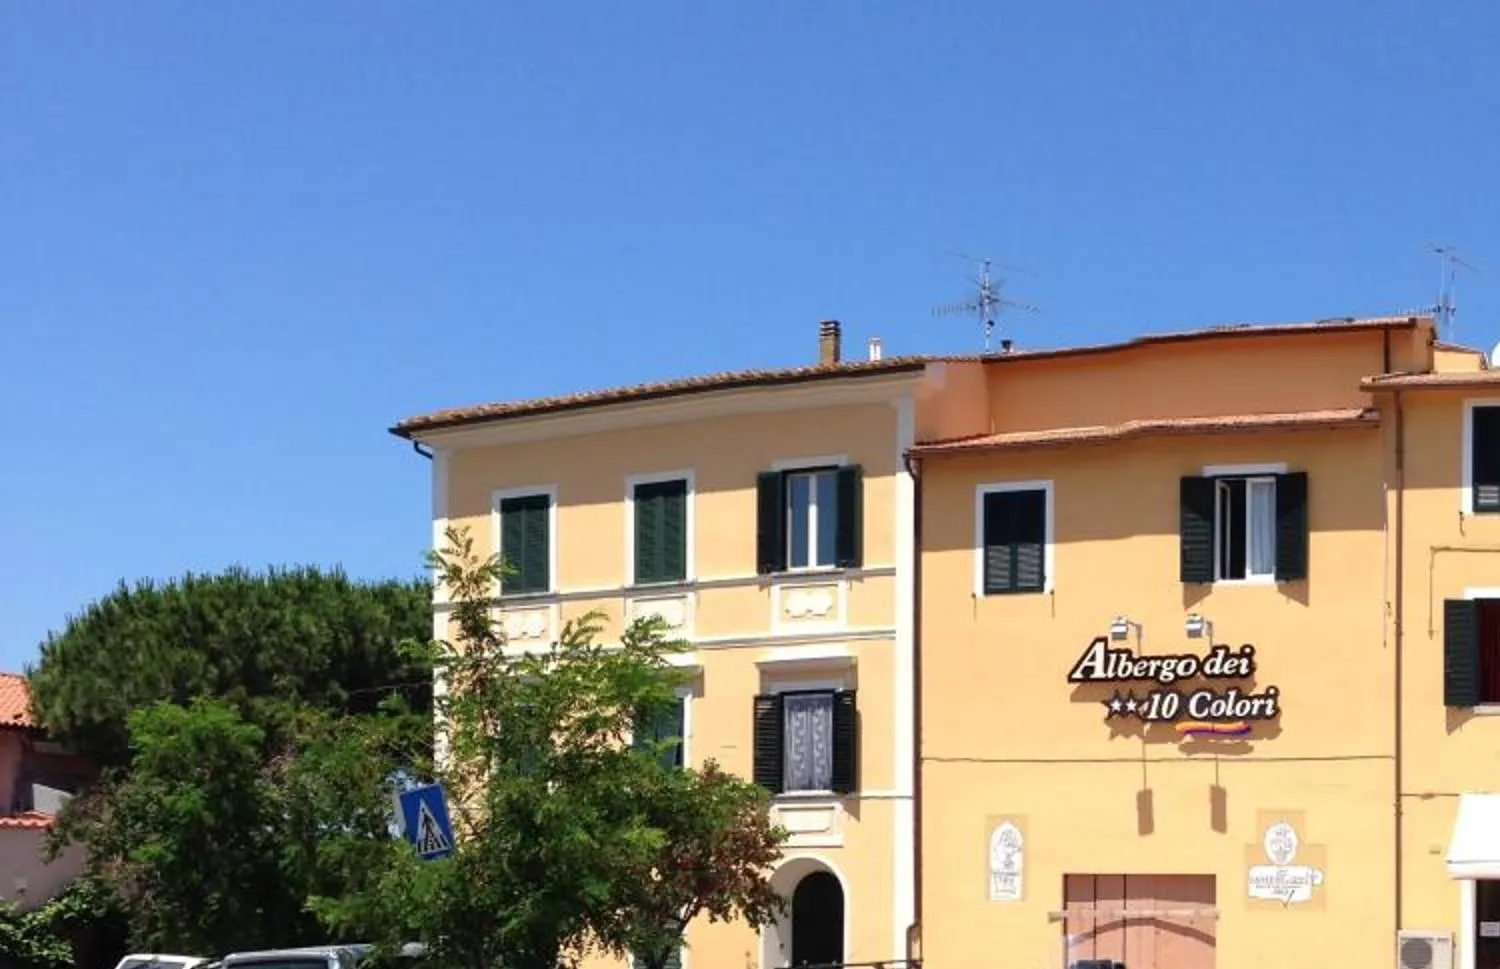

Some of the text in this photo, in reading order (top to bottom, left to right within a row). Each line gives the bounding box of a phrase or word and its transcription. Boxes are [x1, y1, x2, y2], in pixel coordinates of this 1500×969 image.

[1069, 639, 1252, 682] Albergo dei
[1147, 688, 1278, 719] 10 Colori
